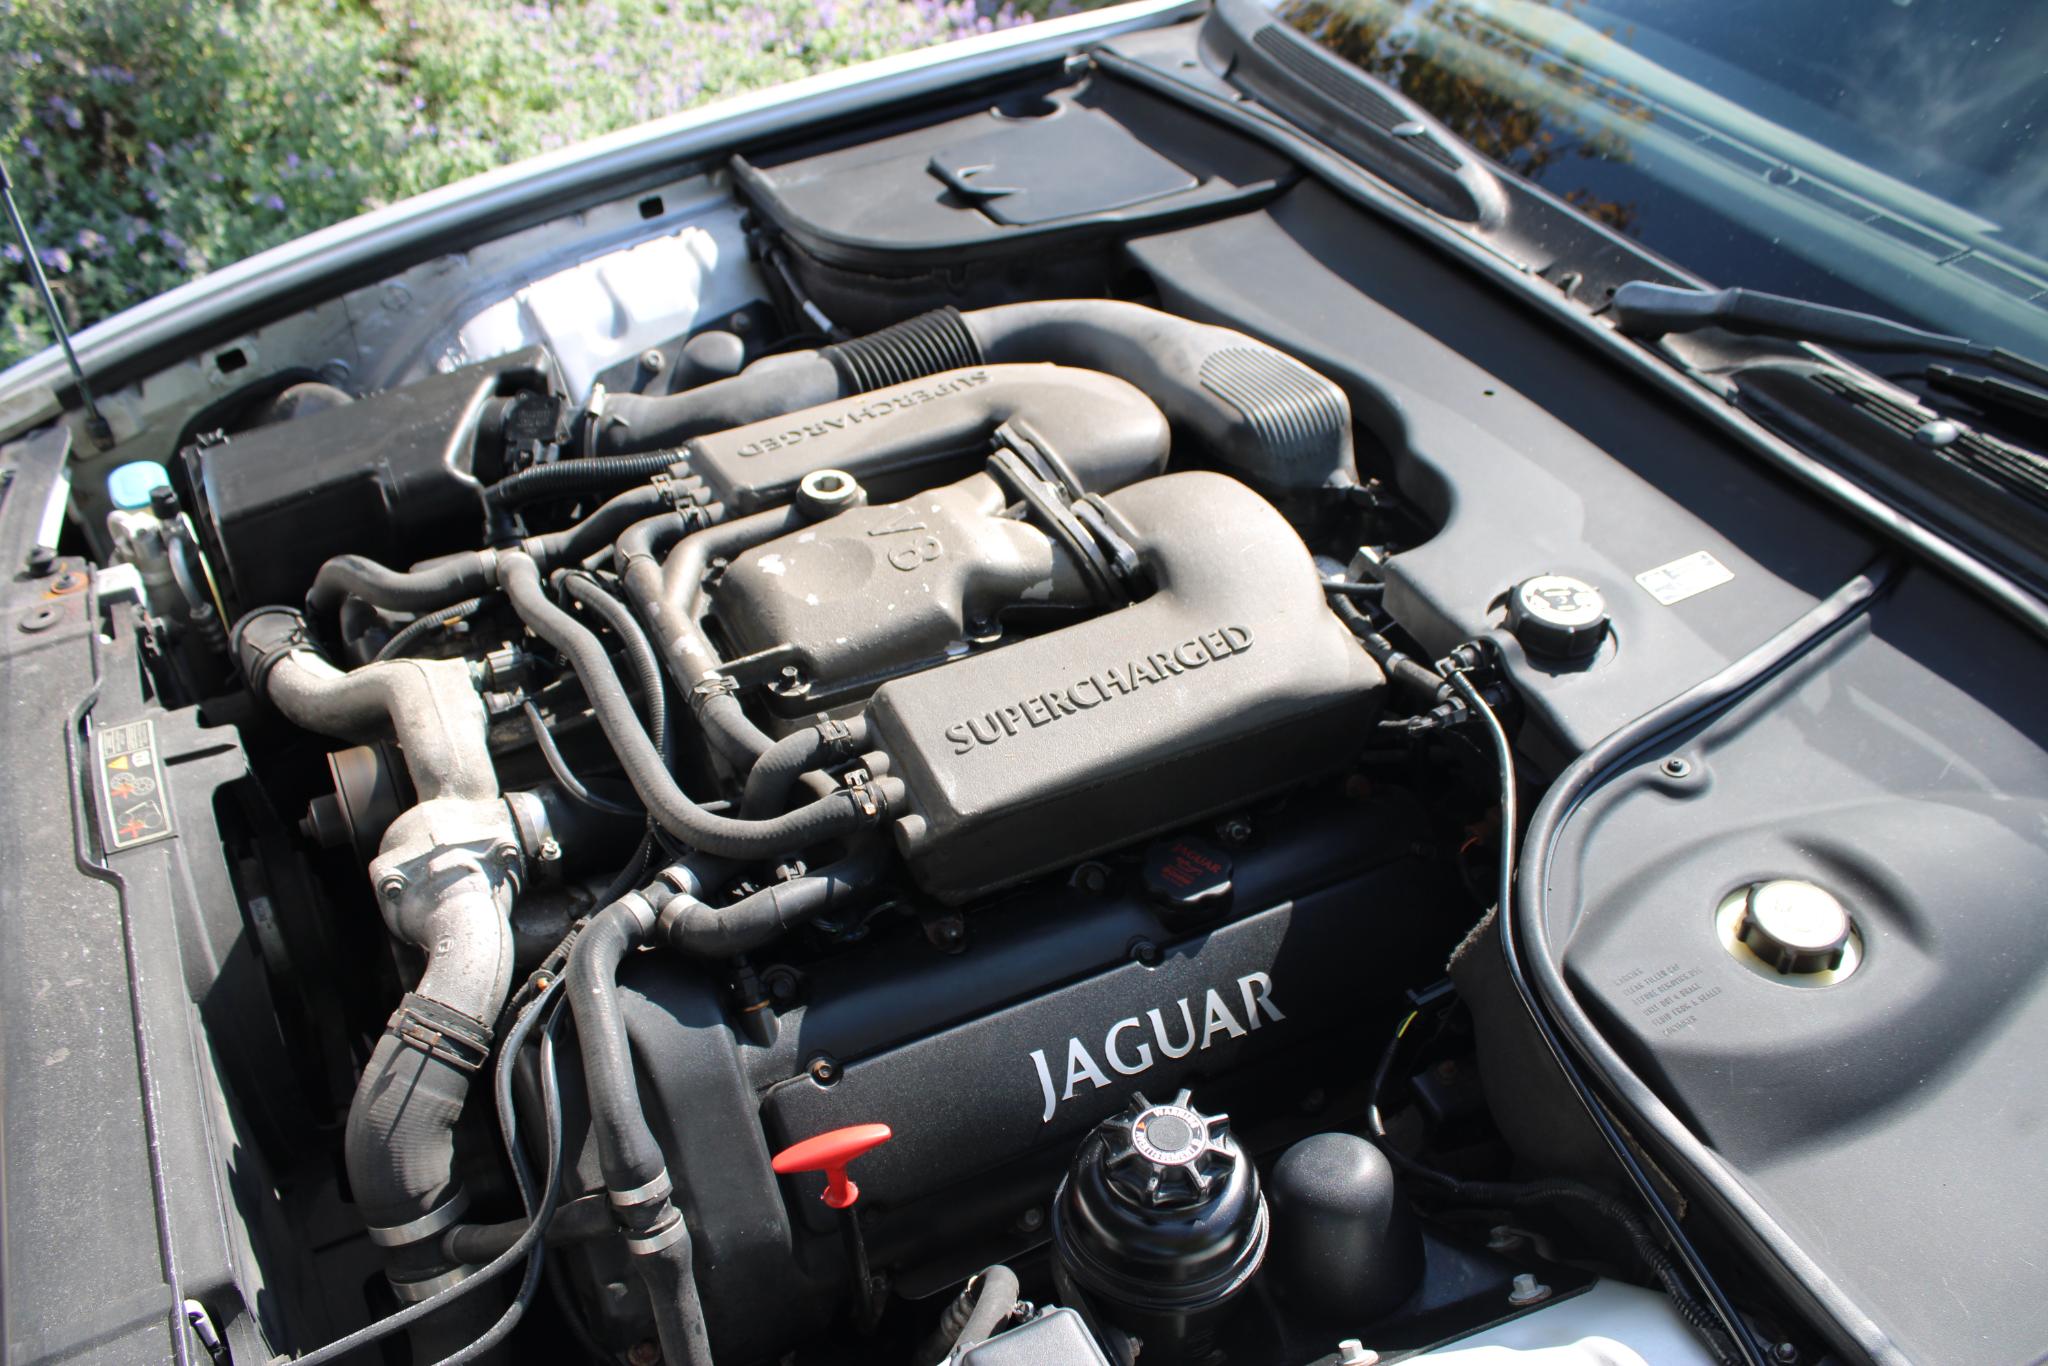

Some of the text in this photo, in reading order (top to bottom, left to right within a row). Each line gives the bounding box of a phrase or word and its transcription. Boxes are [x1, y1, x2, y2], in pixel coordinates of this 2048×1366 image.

[737, 370, 991, 458] SUPERCHARGED
[945, 624, 1255, 755] SUPERCHARGED
[1029, 971, 1286, 1123] JAGUAR
[1152, 1106, 1201, 1130] WARNING
